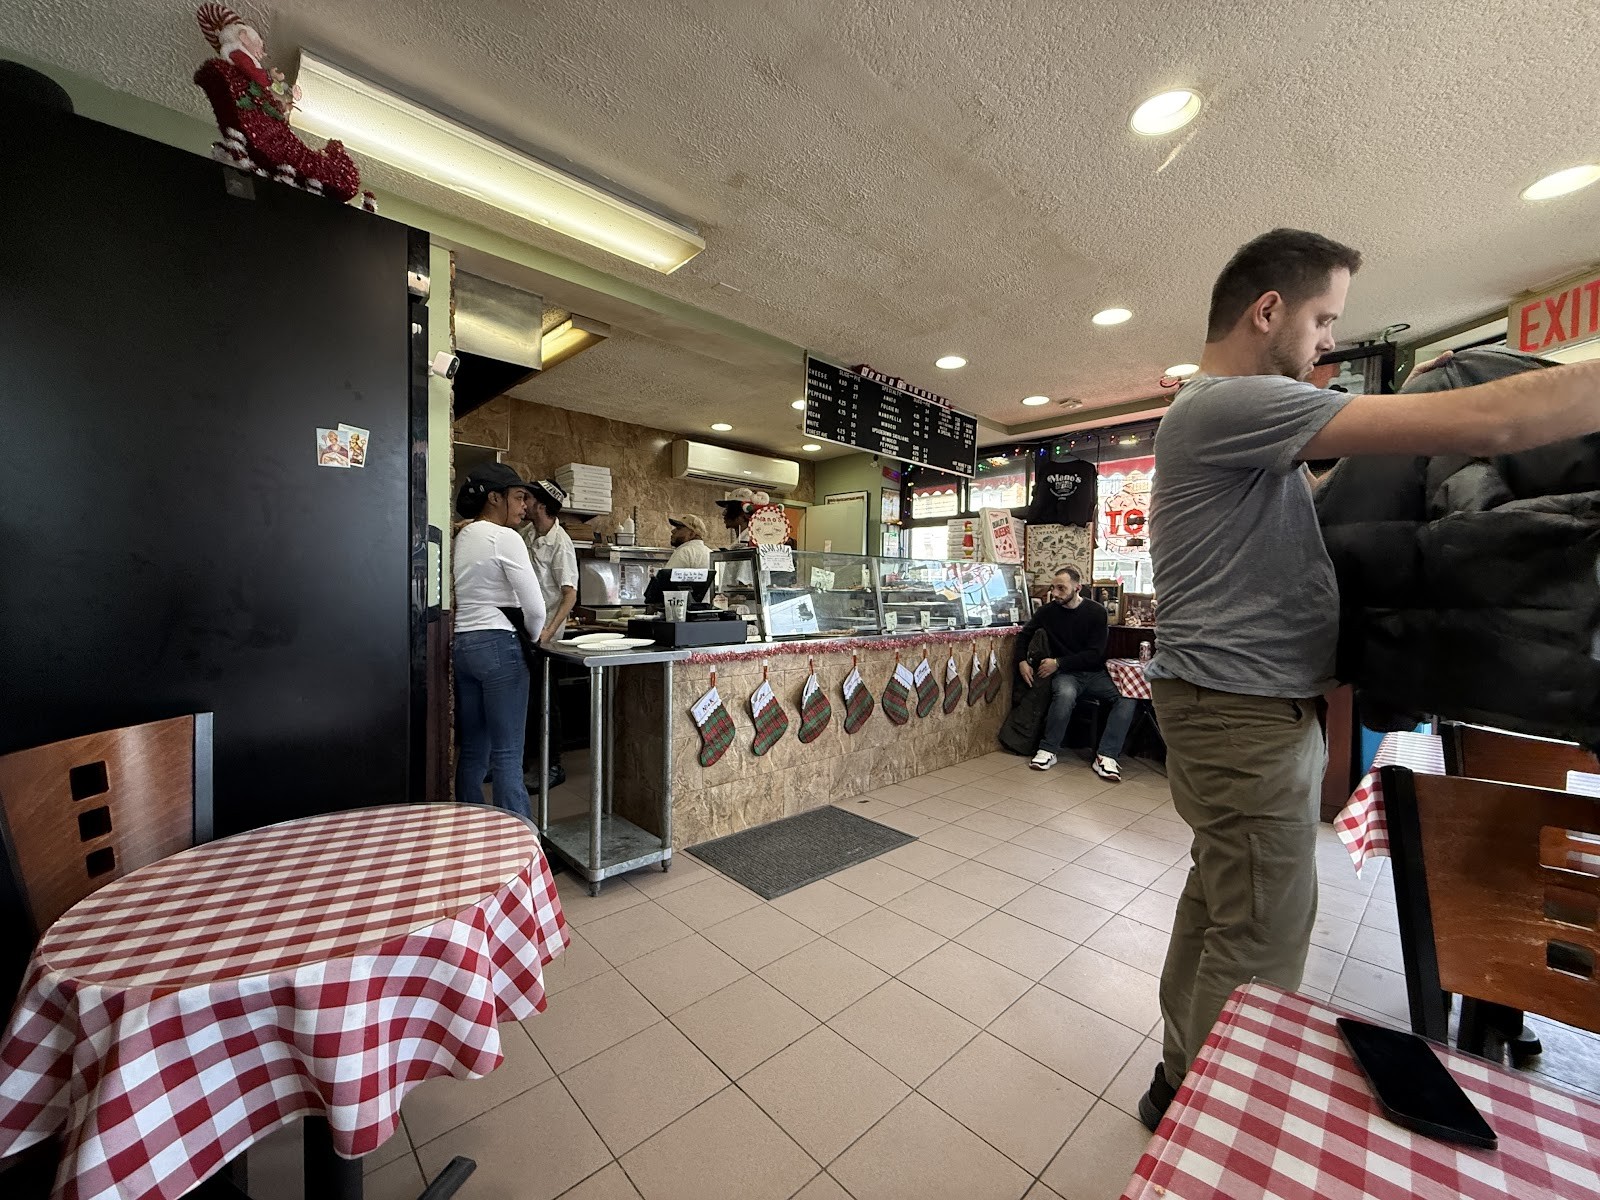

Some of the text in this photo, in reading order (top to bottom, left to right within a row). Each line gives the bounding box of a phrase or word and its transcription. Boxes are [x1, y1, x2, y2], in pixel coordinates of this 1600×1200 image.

[1519, 279, 1600, 352] EXIT
[808, 368, 828, 380] CHEESE
[808, 390, 832, 402] PEPPERONI
